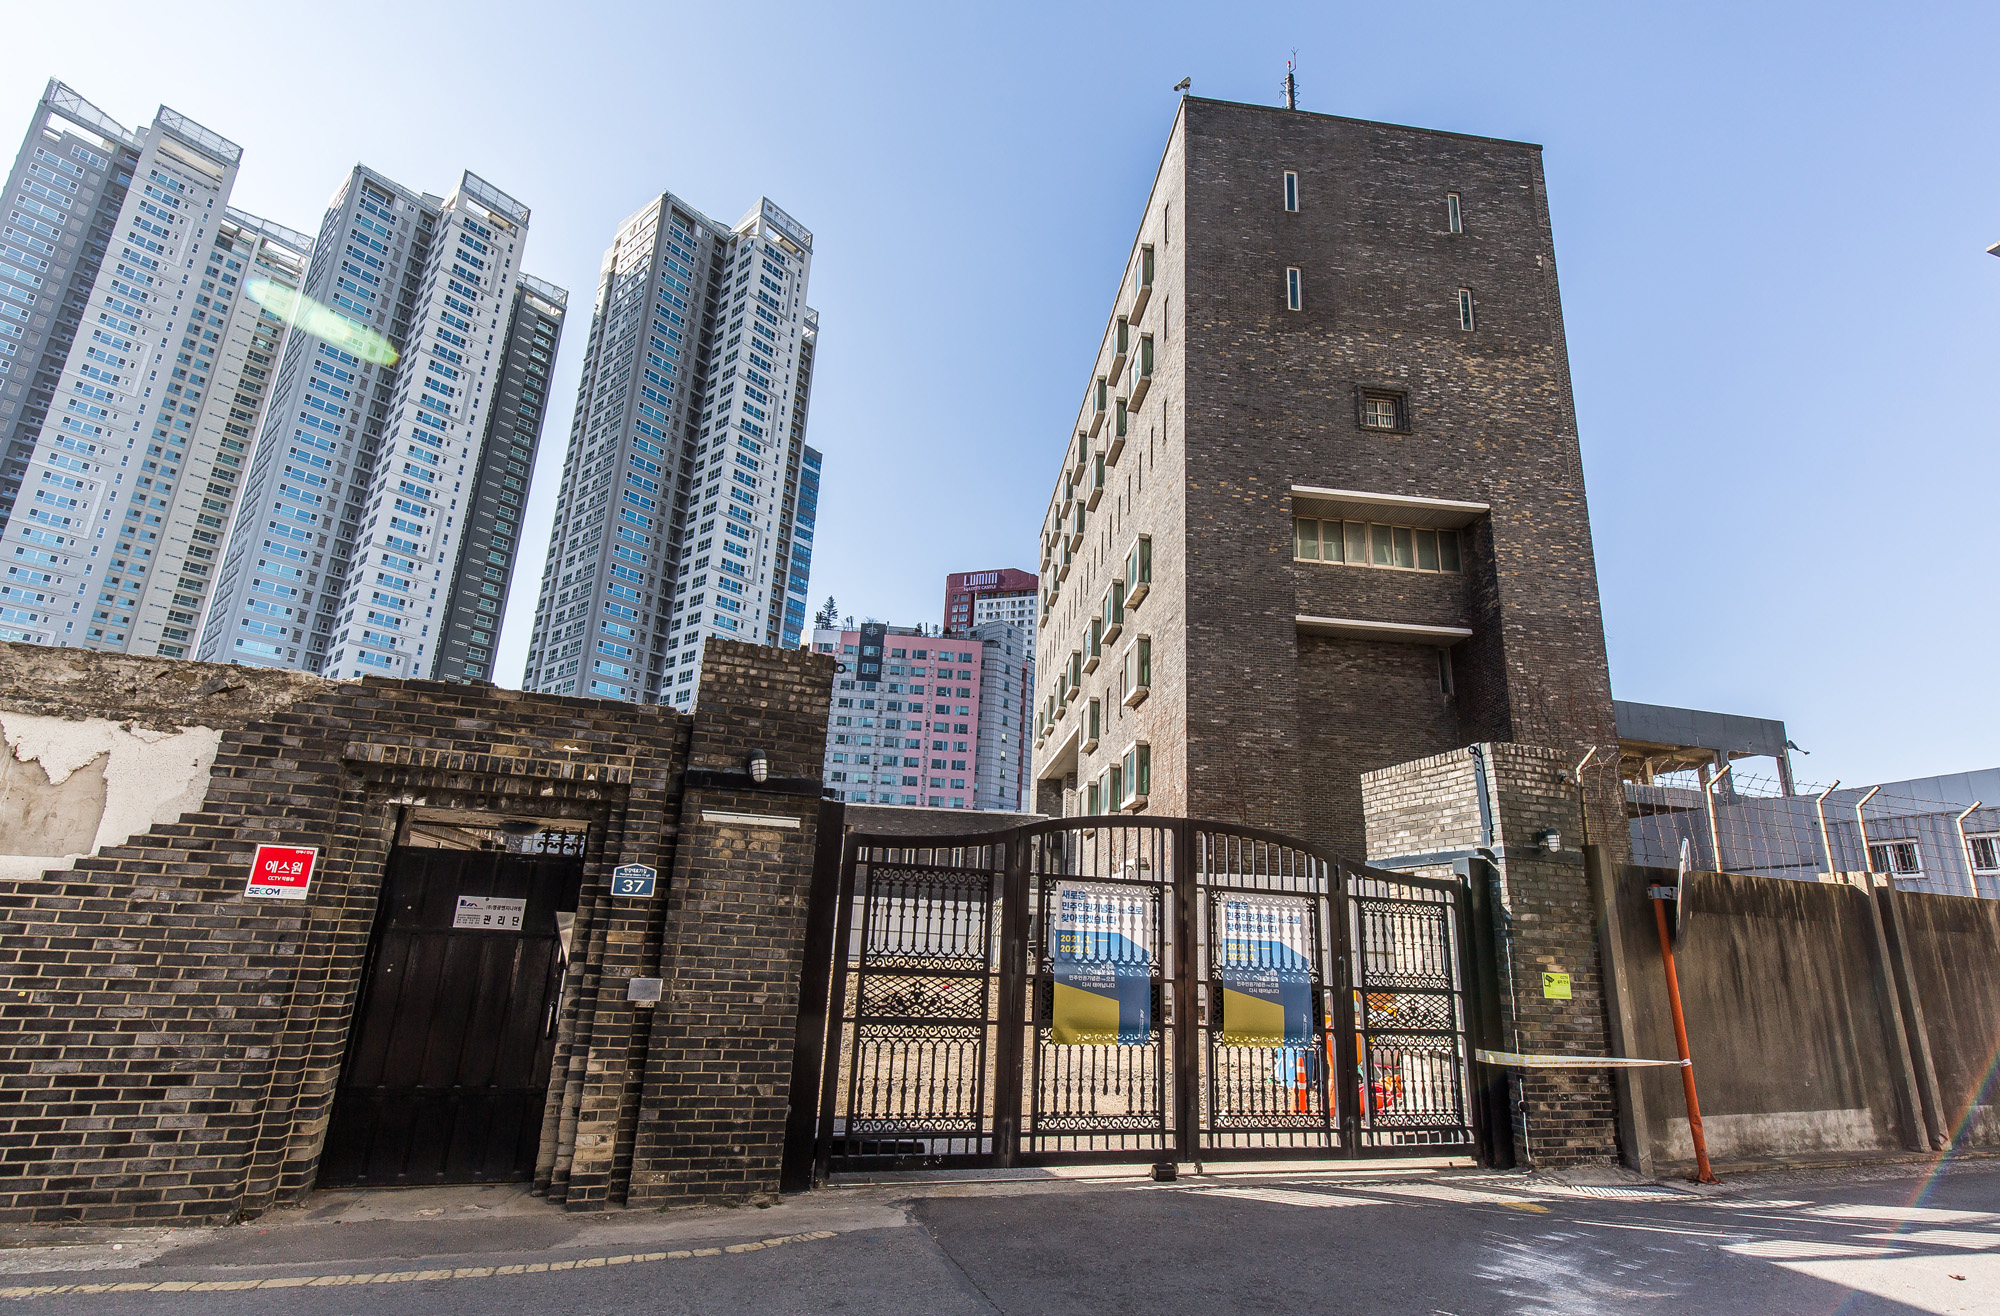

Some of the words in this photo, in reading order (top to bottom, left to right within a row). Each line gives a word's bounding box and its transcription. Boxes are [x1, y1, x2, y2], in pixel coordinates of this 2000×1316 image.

[265, 860, 303, 875] 에스원
[621, 879, 645, 893] 37
[248, 887, 281, 896] SECOM
[1061, 890, 1086, 900] 새로운
[1226, 901, 1248, 910] 새로운
[1060, 934, 1083, 944] 2021.
[1084, 936, 1093, 944] 3.
[1060, 945, 1083, 953] 2023.
[1084, 946, 1093, 954] 6.
[1226, 943, 1248, 951] 2021.
[1226, 952, 1248, 961] 2023.
